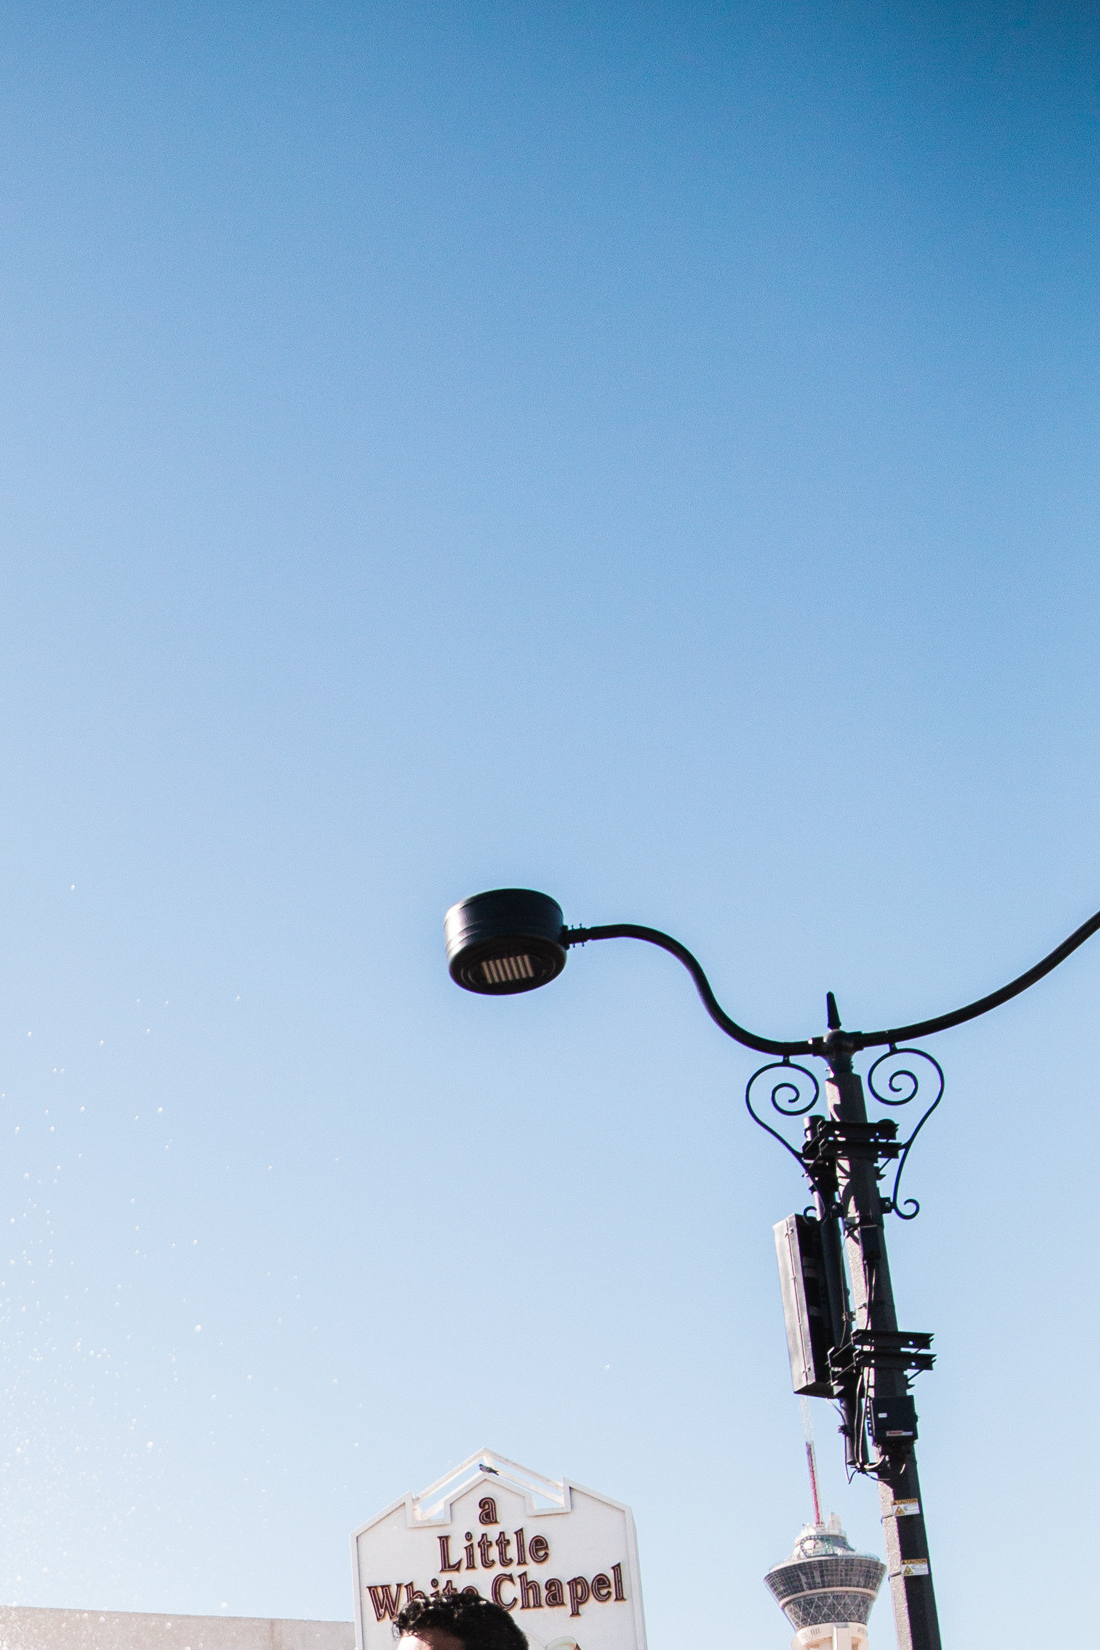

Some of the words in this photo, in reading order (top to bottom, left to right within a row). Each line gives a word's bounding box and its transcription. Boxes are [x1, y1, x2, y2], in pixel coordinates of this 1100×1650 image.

[478, 1496, 500, 1525] a
[437, 1527, 550, 1573] Little
[491, 1562, 628, 1618] Chapel
